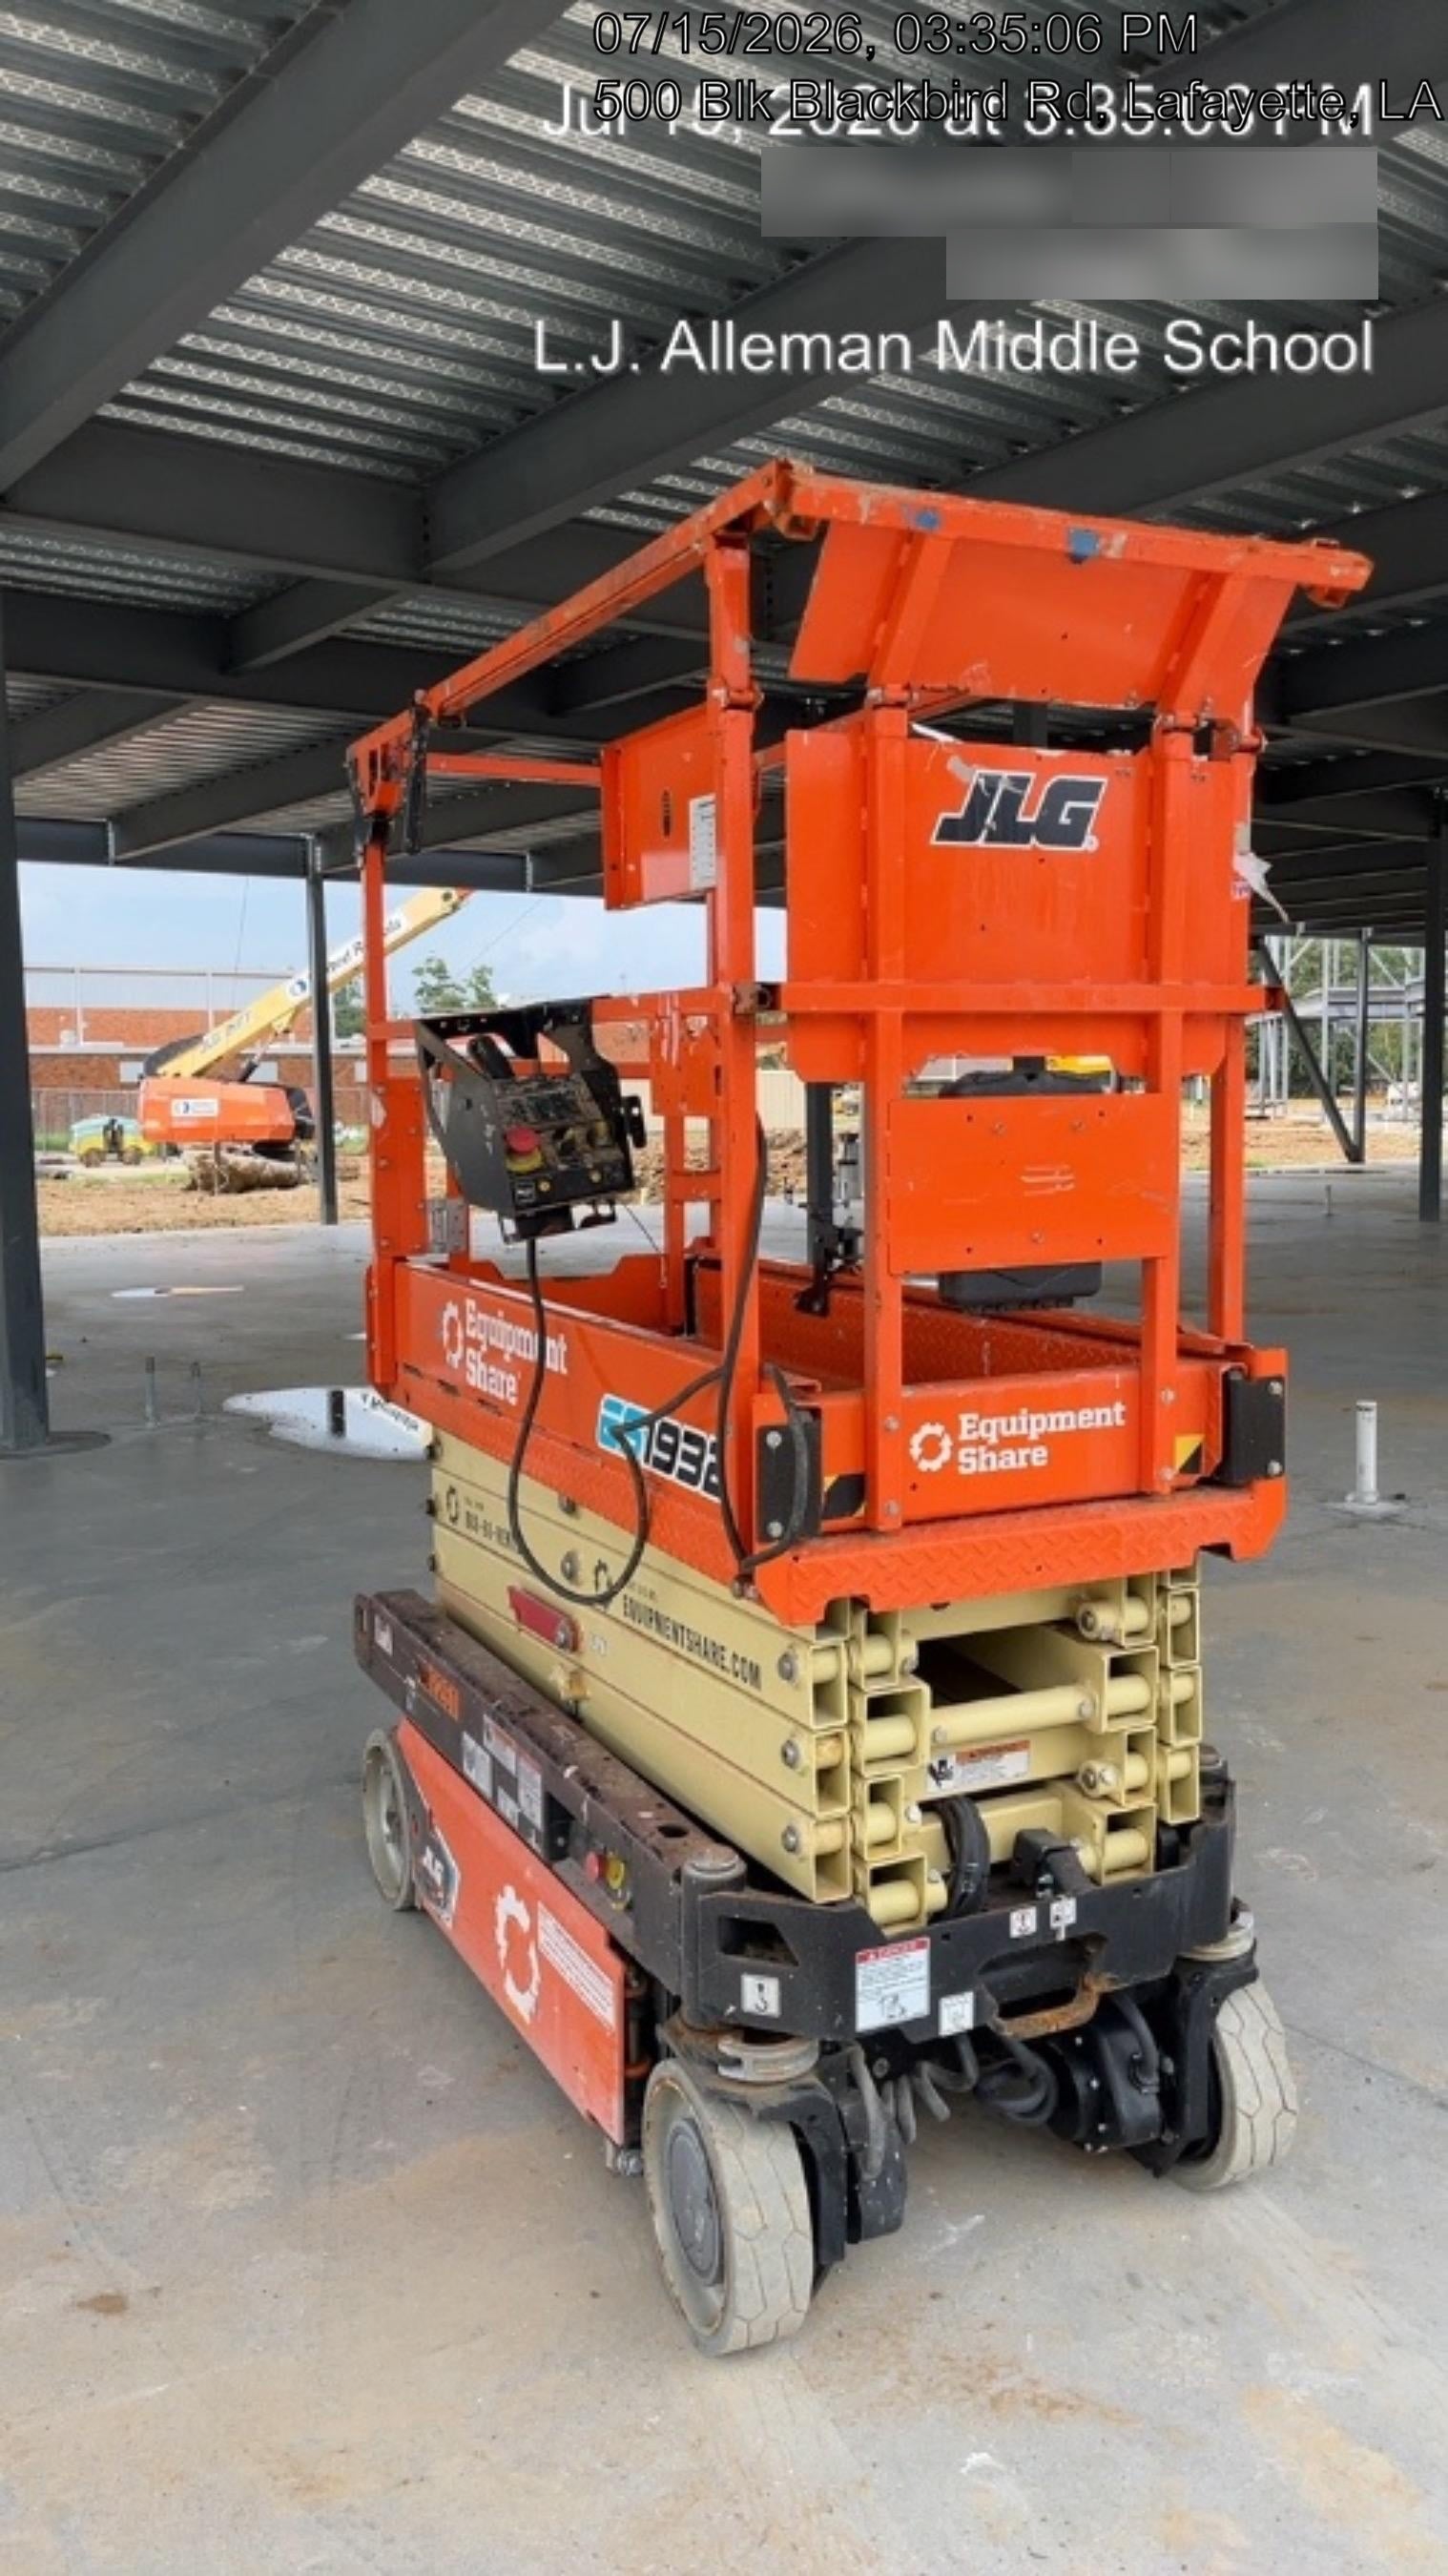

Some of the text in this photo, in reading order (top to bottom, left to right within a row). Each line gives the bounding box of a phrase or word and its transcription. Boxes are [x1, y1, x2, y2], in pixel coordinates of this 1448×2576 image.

[929, 769, 1109, 852] JLG
[465, 1298, 568, 1375] Equipmnt
[465, 1348, 516, 1406] Share
[958, 1402, 1126, 1444] Equipment
[958, 1445, 1048, 1475] Share
